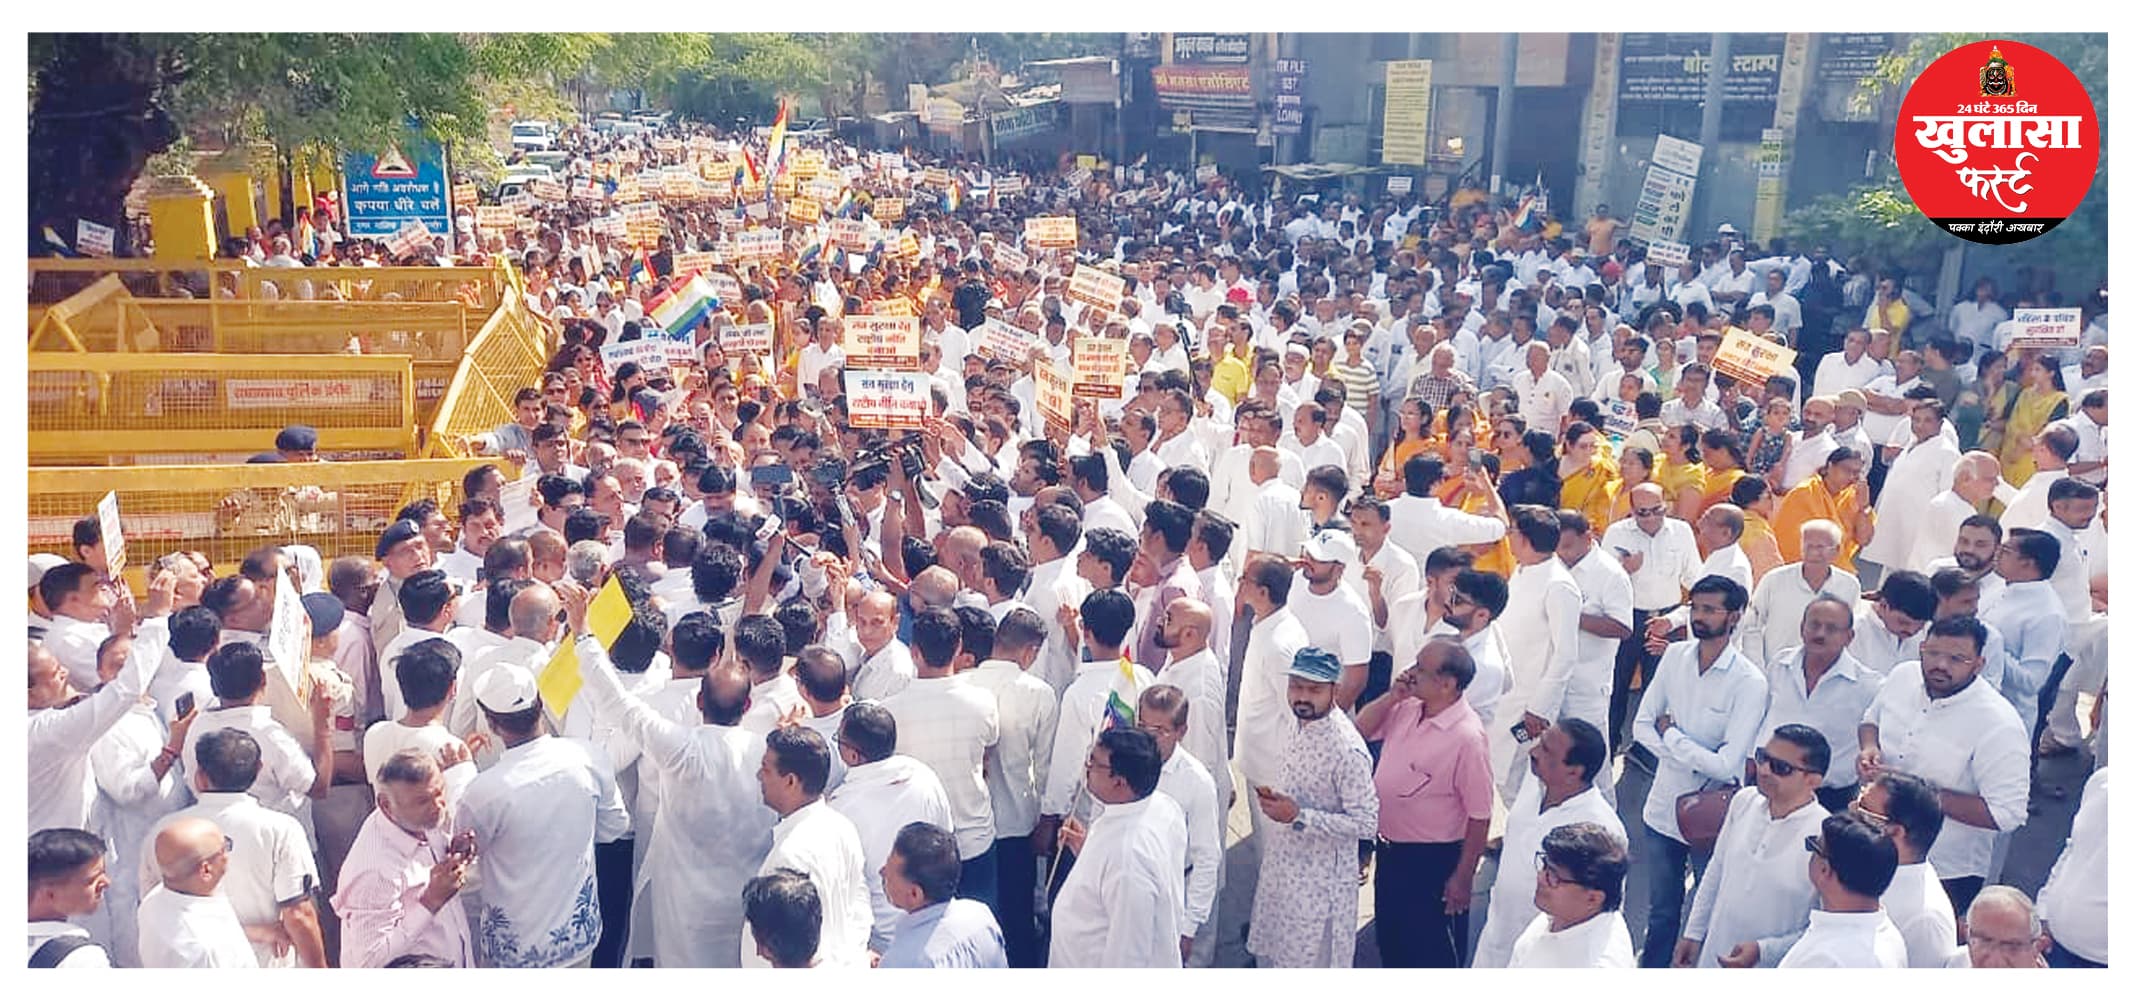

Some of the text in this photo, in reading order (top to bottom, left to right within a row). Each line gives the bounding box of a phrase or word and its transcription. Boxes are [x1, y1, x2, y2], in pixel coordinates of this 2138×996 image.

[351, 181, 369, 194] आगे
[392, 181, 429, 193] अवरोधक
[433, 180, 440, 194] है
[354, 195, 440, 215] कृपया धीरे चलें
